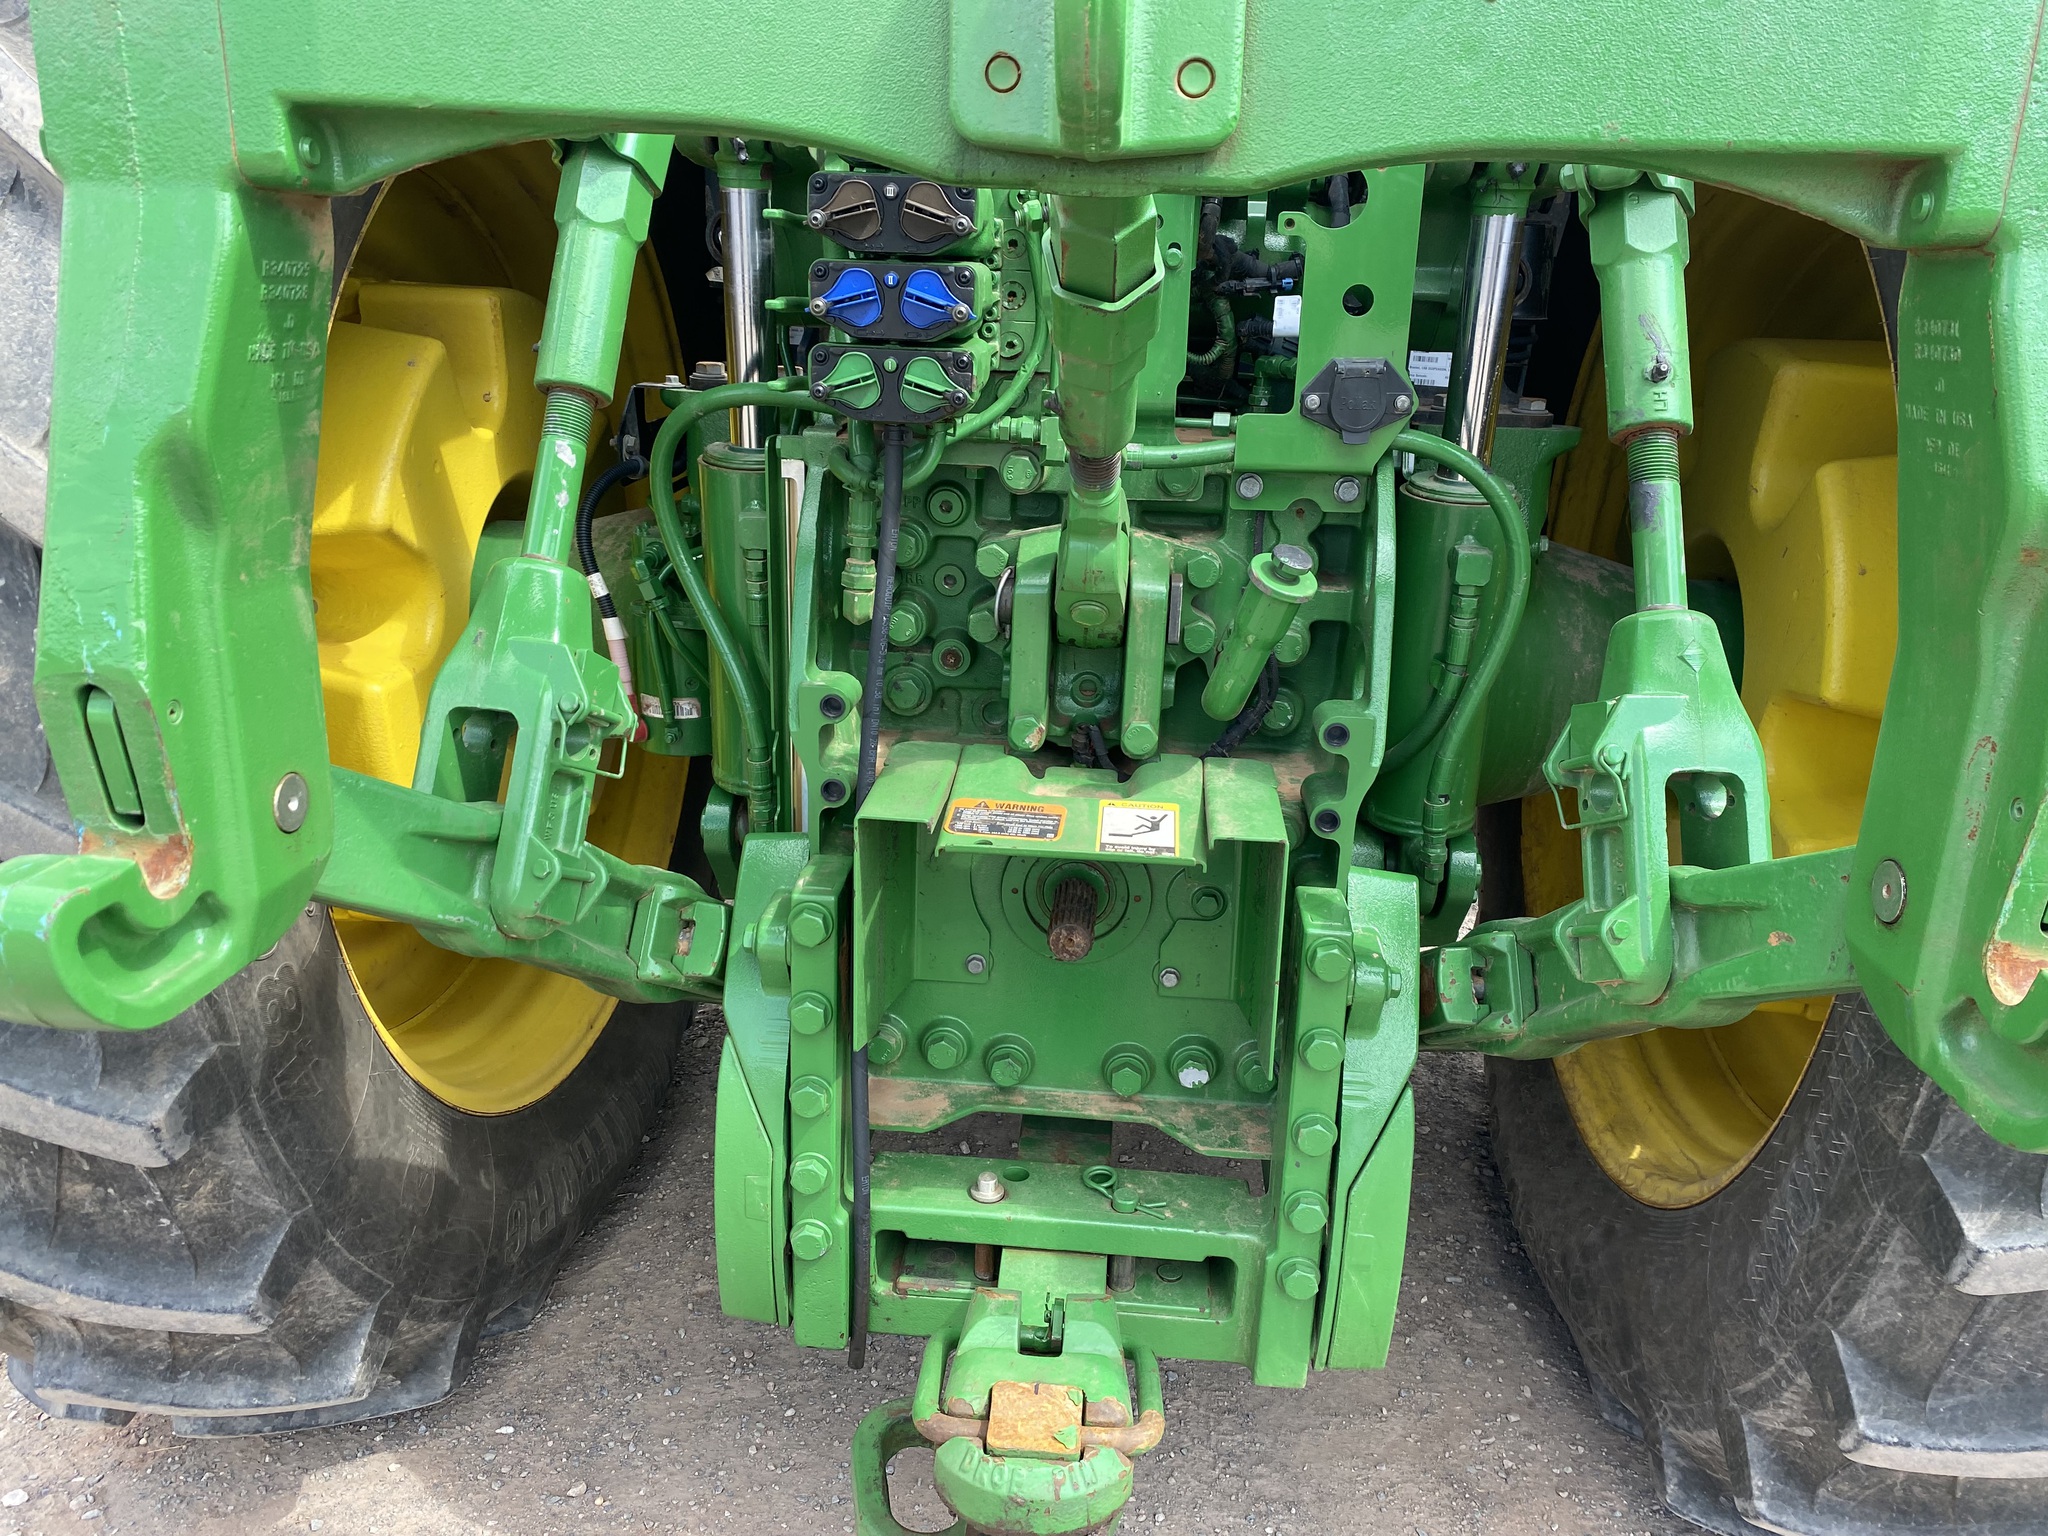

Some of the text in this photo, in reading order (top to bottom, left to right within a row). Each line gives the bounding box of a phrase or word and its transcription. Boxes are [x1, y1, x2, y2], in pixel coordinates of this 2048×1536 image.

[889, 528, 900, 552] EATON
[883, 575, 894, 610] AEROQUIP
[994, 802, 1045, 813] WARNING
[861, 1175, 870, 1195] EATON
[958, 1444, 1098, 1502] DROP PIN
